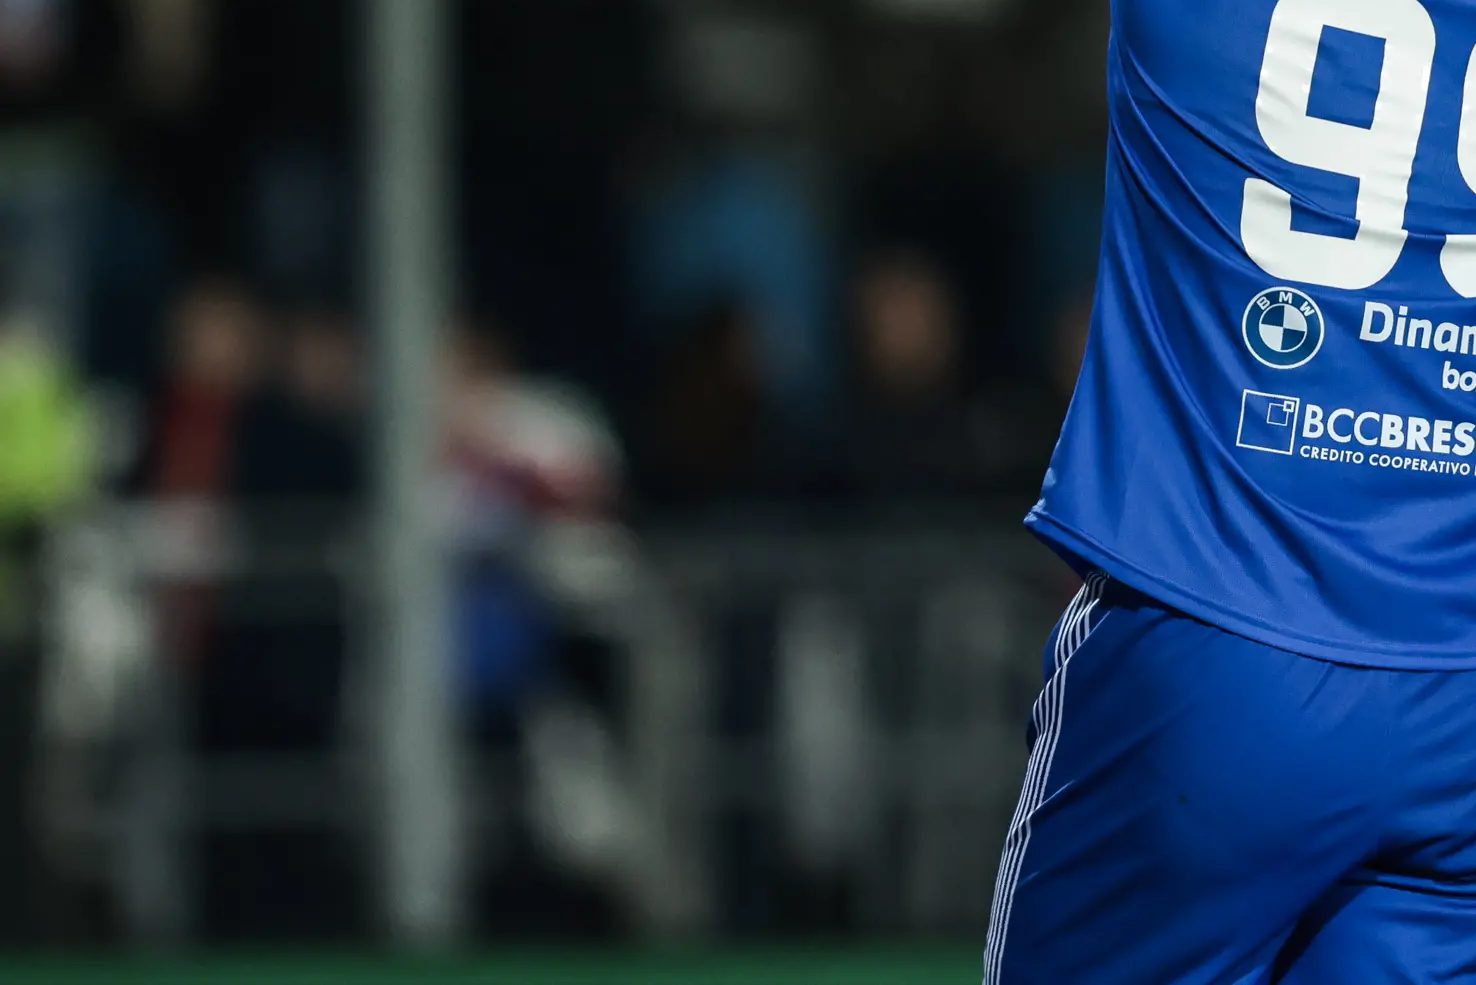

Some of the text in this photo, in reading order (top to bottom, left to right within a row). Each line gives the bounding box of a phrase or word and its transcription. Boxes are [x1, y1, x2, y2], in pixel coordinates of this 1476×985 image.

[1256, 291, 1315, 316] BMW
[1300, 446, 1364, 464] CREDITO
[1369, 454, 1470, 476] COOPERATIVO
